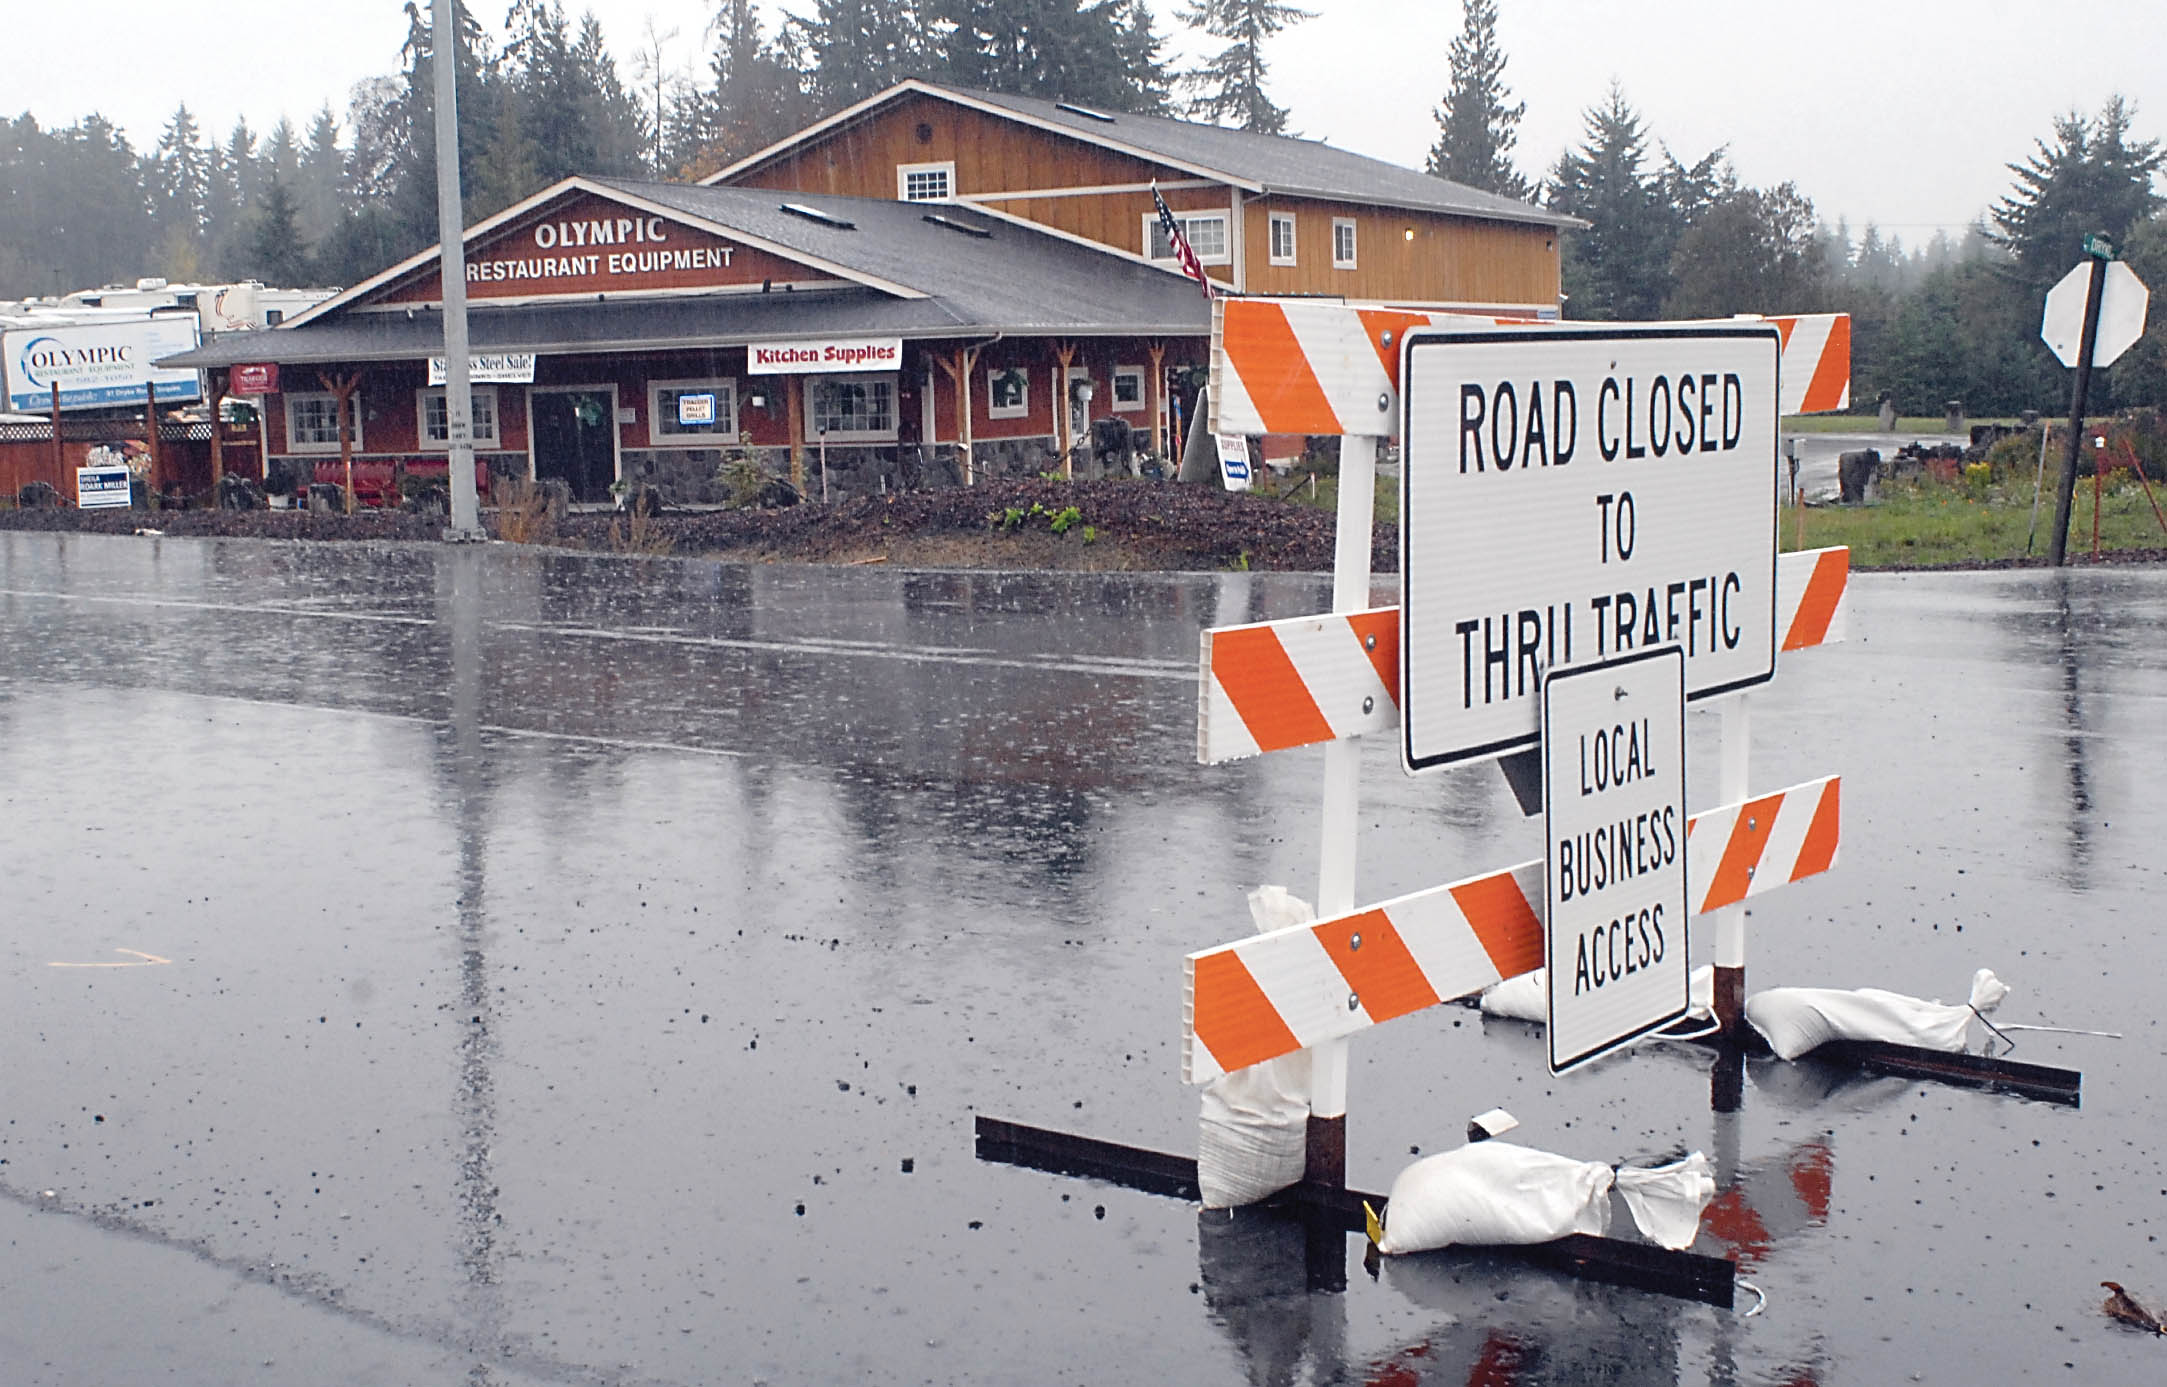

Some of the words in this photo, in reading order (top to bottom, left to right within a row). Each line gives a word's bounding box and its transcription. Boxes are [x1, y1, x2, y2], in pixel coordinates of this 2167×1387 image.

[535, 217, 667, 249] OLYMPIC
[466, 255, 600, 283] RESTAURANT
[608, 247, 734, 274] EQUIPMENT
[32, 346, 132, 368] OLYMPIC
[480, 355, 505, 370] Steel
[506, 354, 532, 369] Sale!
[756, 348, 819, 364] Kitchen
[824, 345, 896, 364] Supplies
[1459, 379, 1577, 474] ROAD
[1599, 373, 1742, 462] CLOSED
[104, 480, 128, 489] MILLER
[1597, 491, 1635, 563] TO
[1456, 603, 1572, 708] THRU
[1591, 572, 1741, 659] TRAFFIC
[1581, 717, 1656, 796] LOCAL
[1560, 805, 1676, 903] BUSINESS
[1575, 903, 1665, 996] ACCESS
